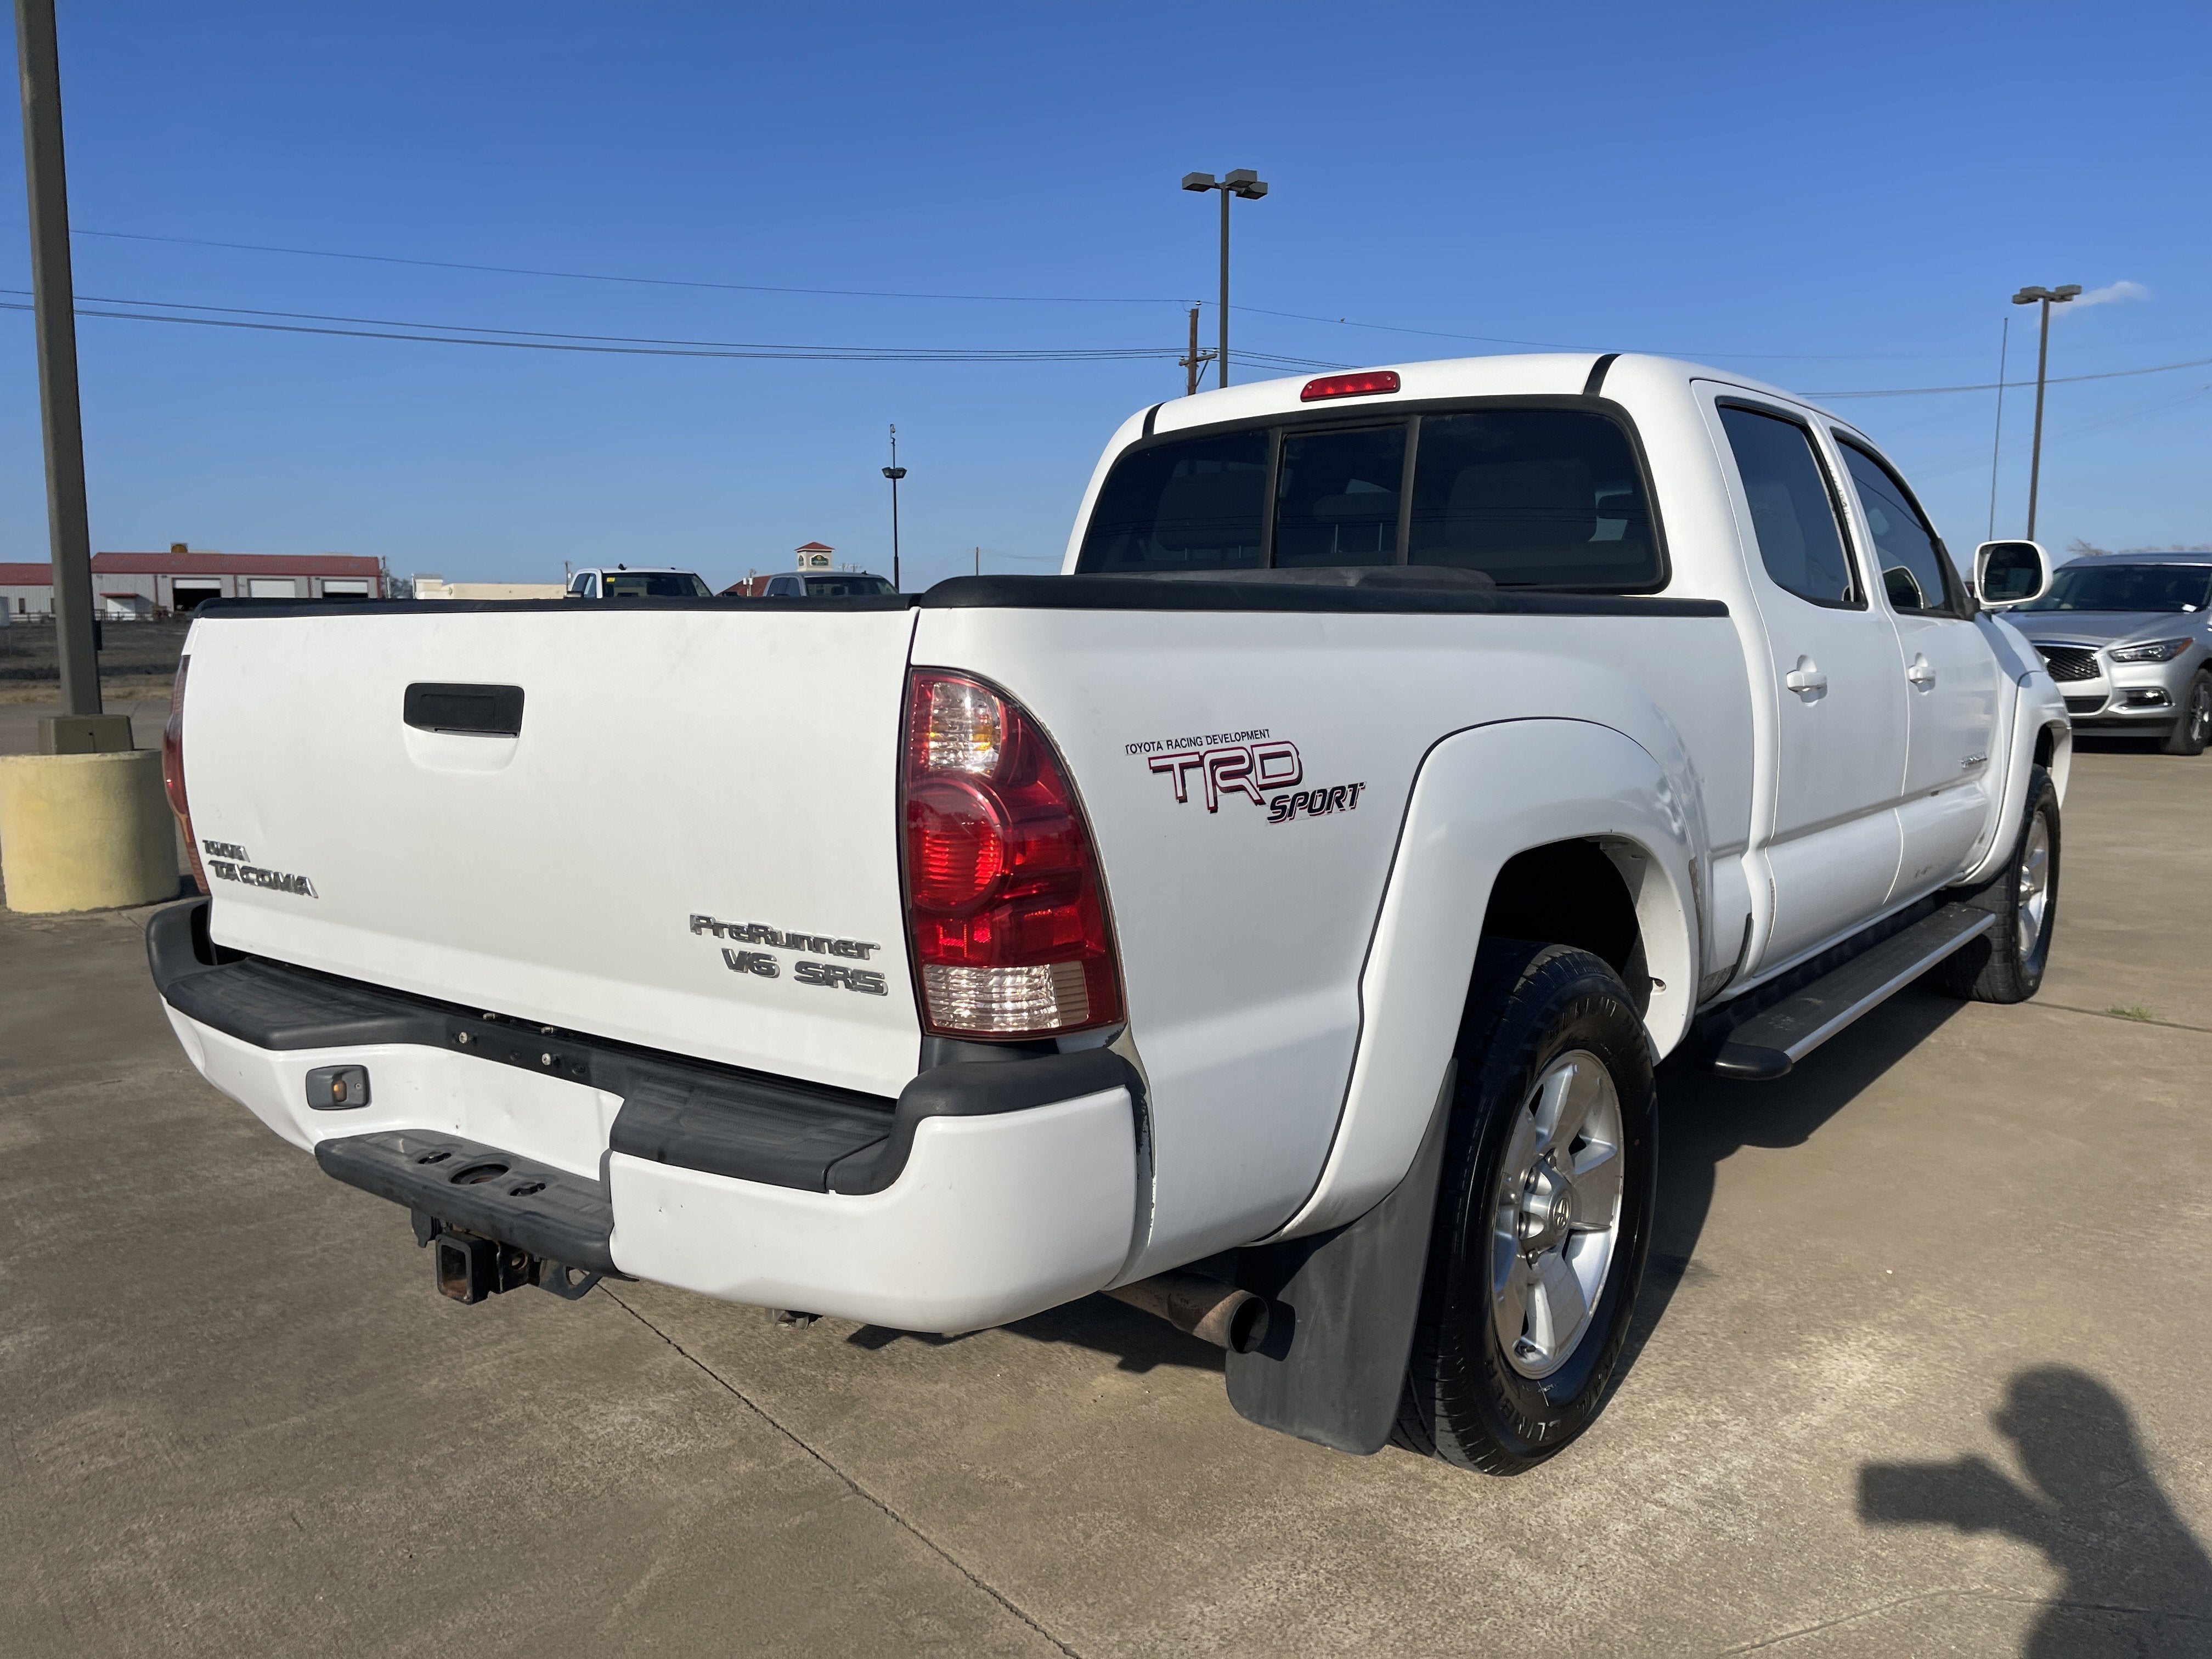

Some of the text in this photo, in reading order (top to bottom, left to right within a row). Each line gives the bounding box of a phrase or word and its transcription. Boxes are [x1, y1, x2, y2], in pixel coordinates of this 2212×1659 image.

[1125, 729, 1271, 754] TOYOTA RACING DEVELOPMENT
[1148, 740, 1304, 814] TRD
[1267, 782, 1366, 823] SPORT
[208, 860, 319, 899] TACOMA
[689, 912, 881, 961] PreRunner
[721, 947, 780, 978] V6
[793, 960, 889, 996] SR5
